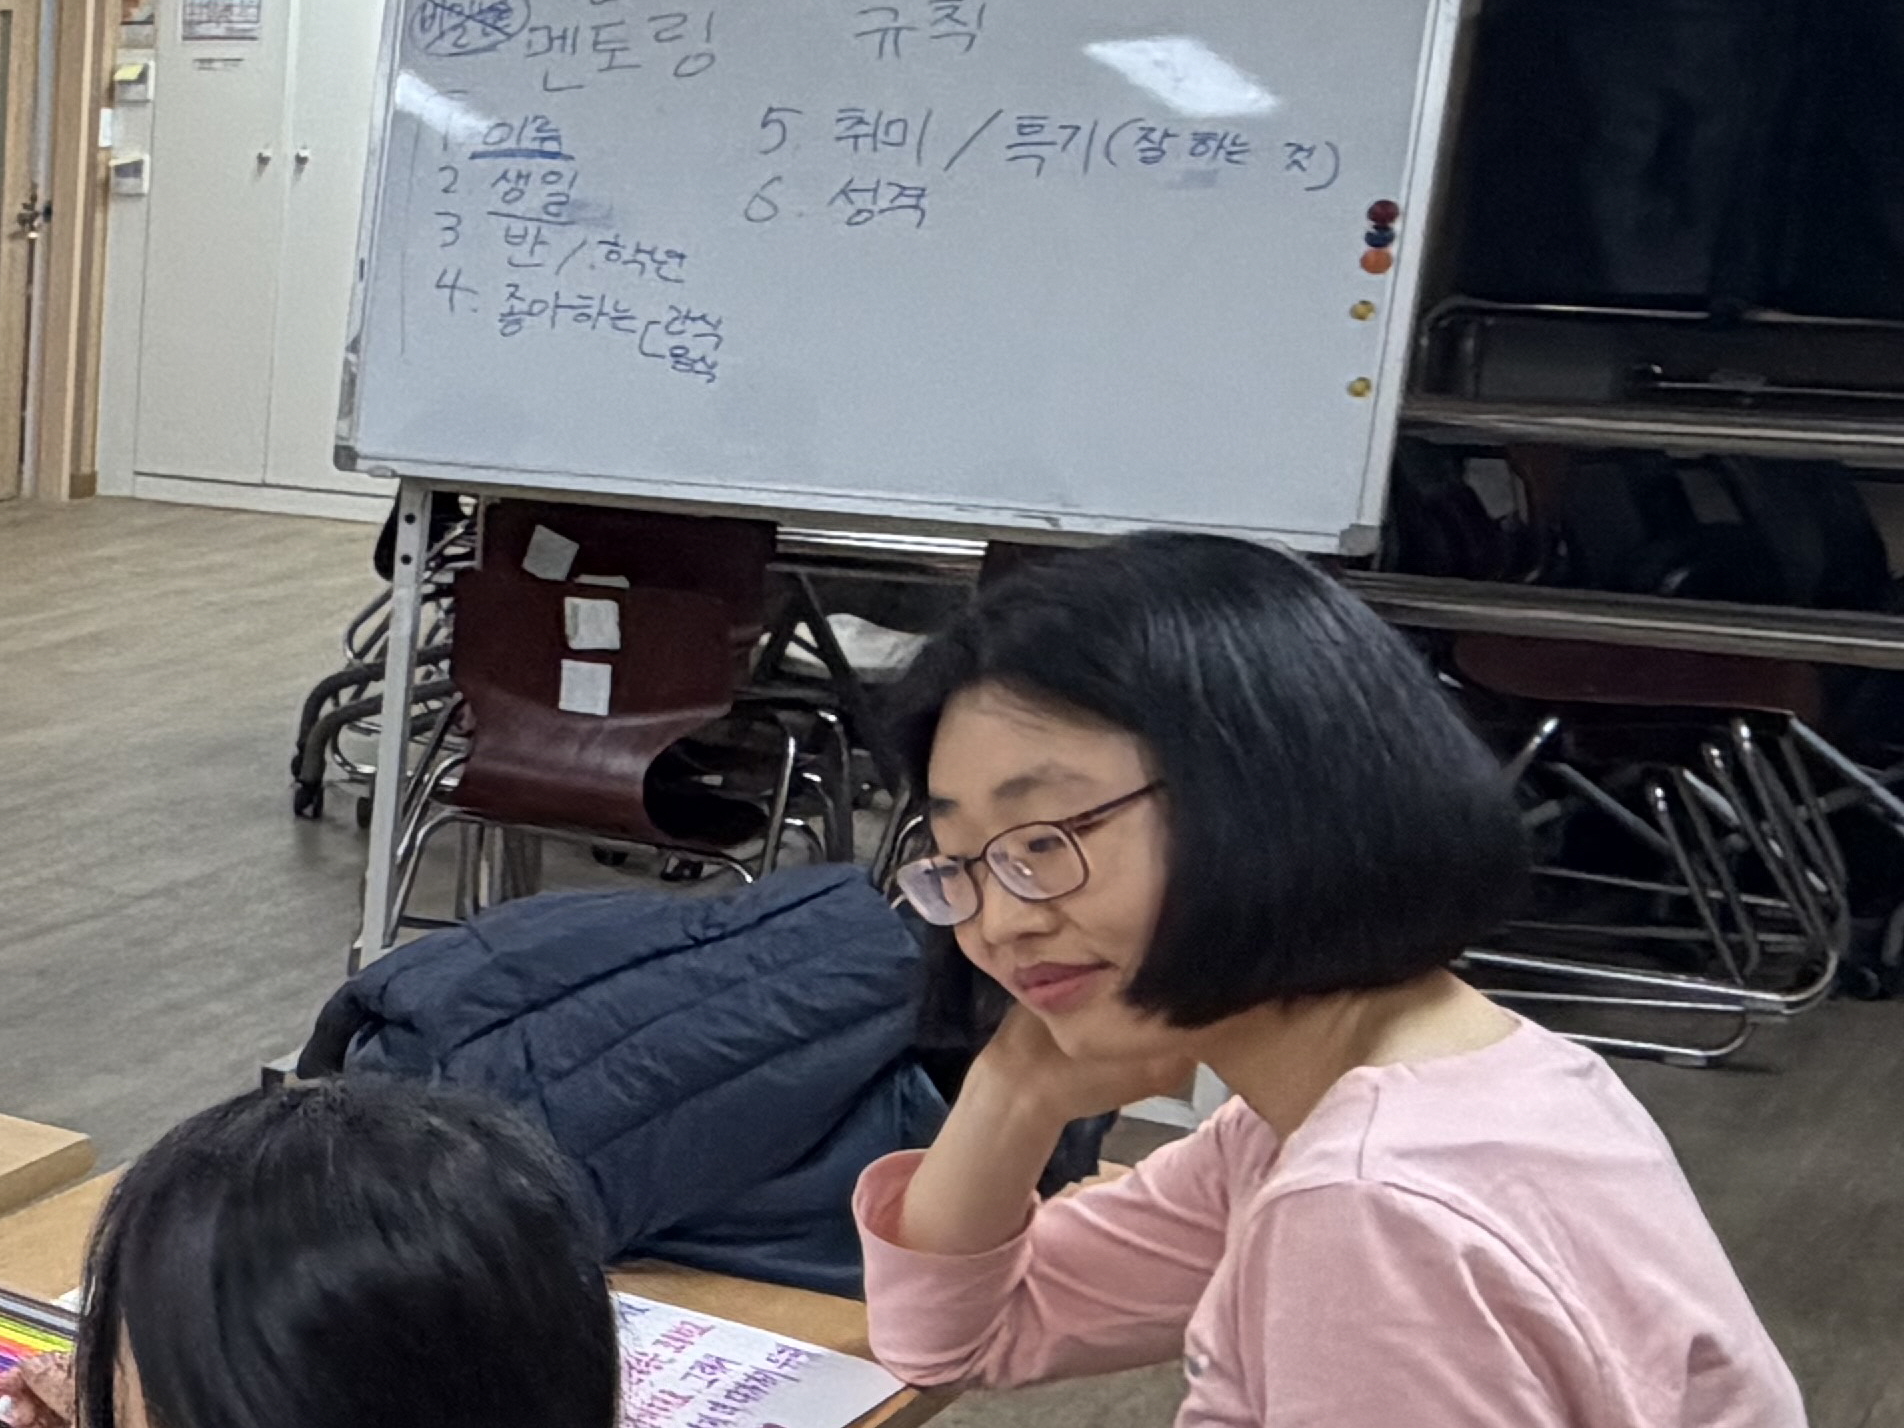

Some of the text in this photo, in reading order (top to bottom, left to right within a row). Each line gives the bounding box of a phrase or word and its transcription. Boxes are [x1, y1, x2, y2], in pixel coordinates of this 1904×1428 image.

[524, 10, 717, 92] 멘토링
[481, 114, 563, 154] 이름
[834, 106, 934, 168] 취미
[489, 168, 579, 218] 생일
[826, 176, 928, 229] 성격
[503, 224, 551, 269] 반
[497, 282, 639, 338] 좋아하는
